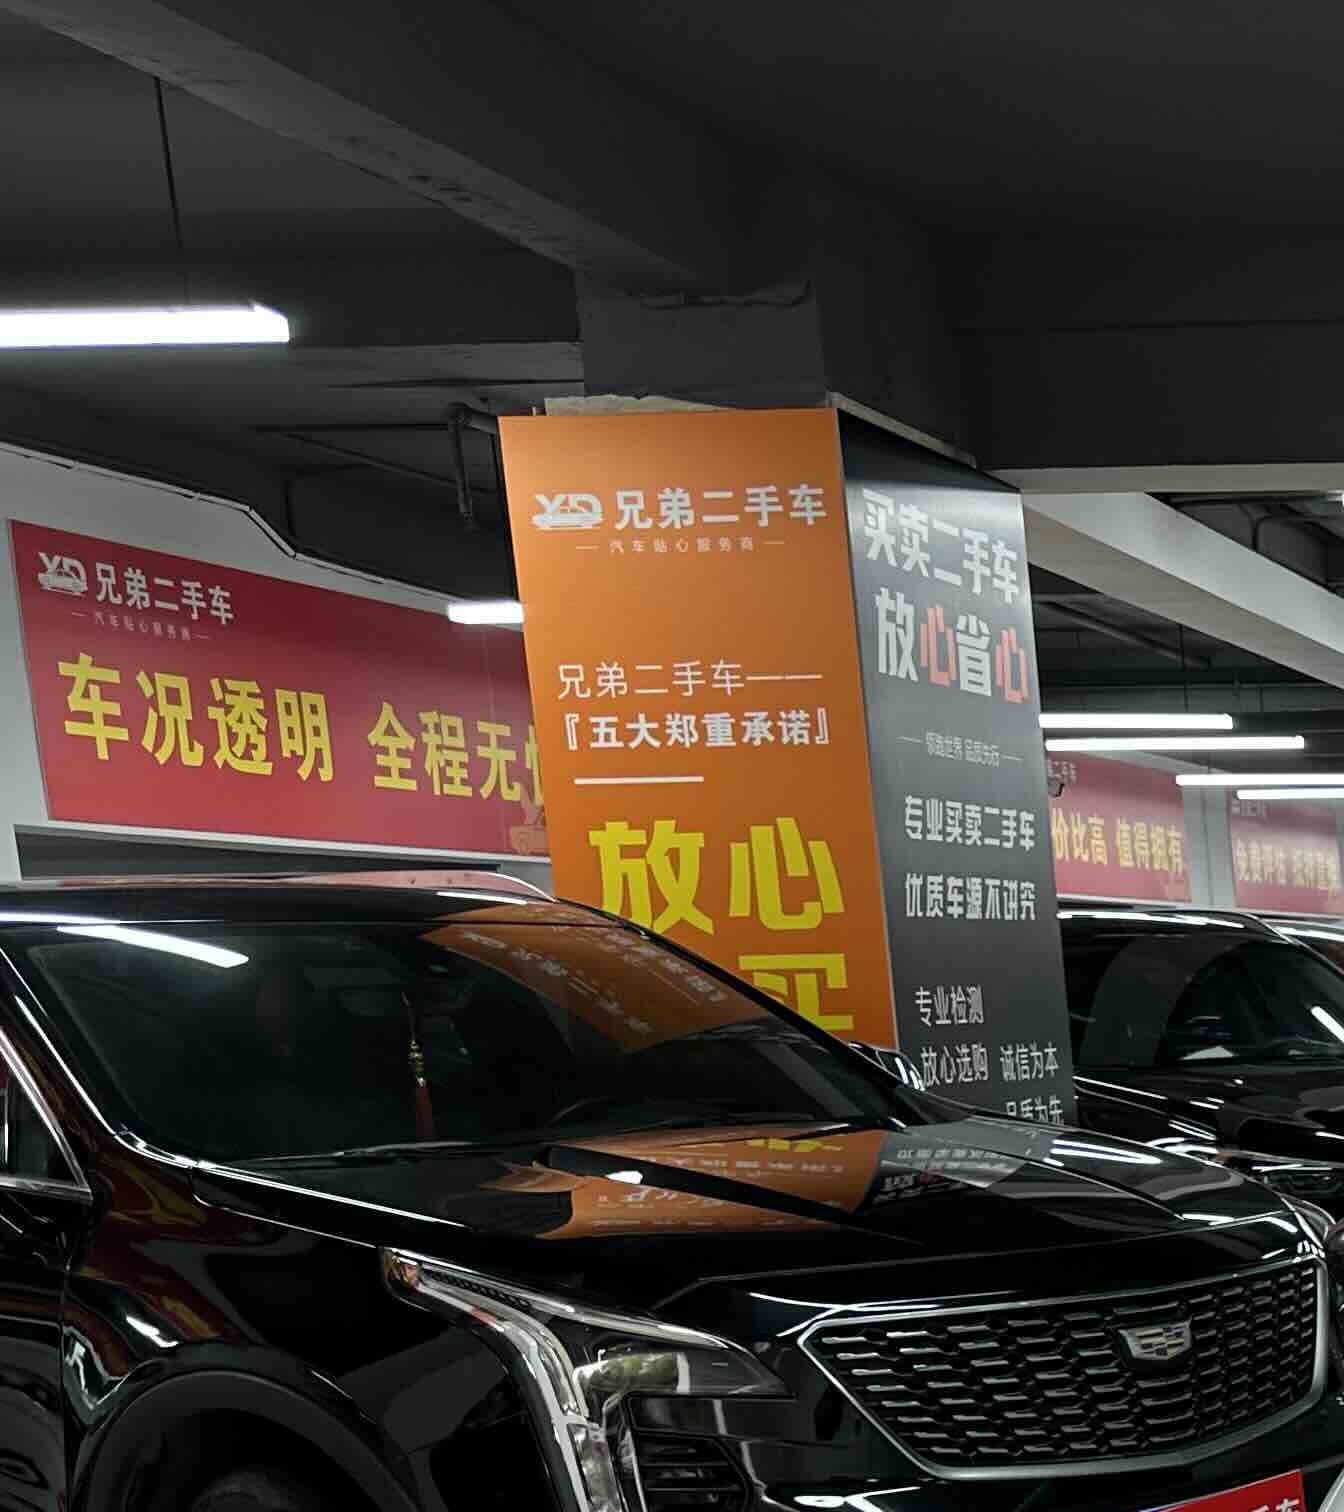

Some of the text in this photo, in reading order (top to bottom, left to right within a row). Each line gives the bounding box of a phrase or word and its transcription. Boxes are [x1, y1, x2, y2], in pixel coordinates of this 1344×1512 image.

[615, 483, 827, 529] 兄弟二手车
[862, 487, 1019, 604] 买卖二手车
[95, 561, 234, 625] 兄弟二手车
[874, 587, 1028, 705] 放心省心
[58, 652, 335, 783] 车况透明
[563, 706, 832, 752] 『五大郑重承诺』
[904, 794, 1036, 851] 专业买卖二手车
[588, 816, 846, 936] 放心
[915, 985, 985, 1026] 专业检测
[920, 1041, 1059, 1087] 放心选购 诚信为本
